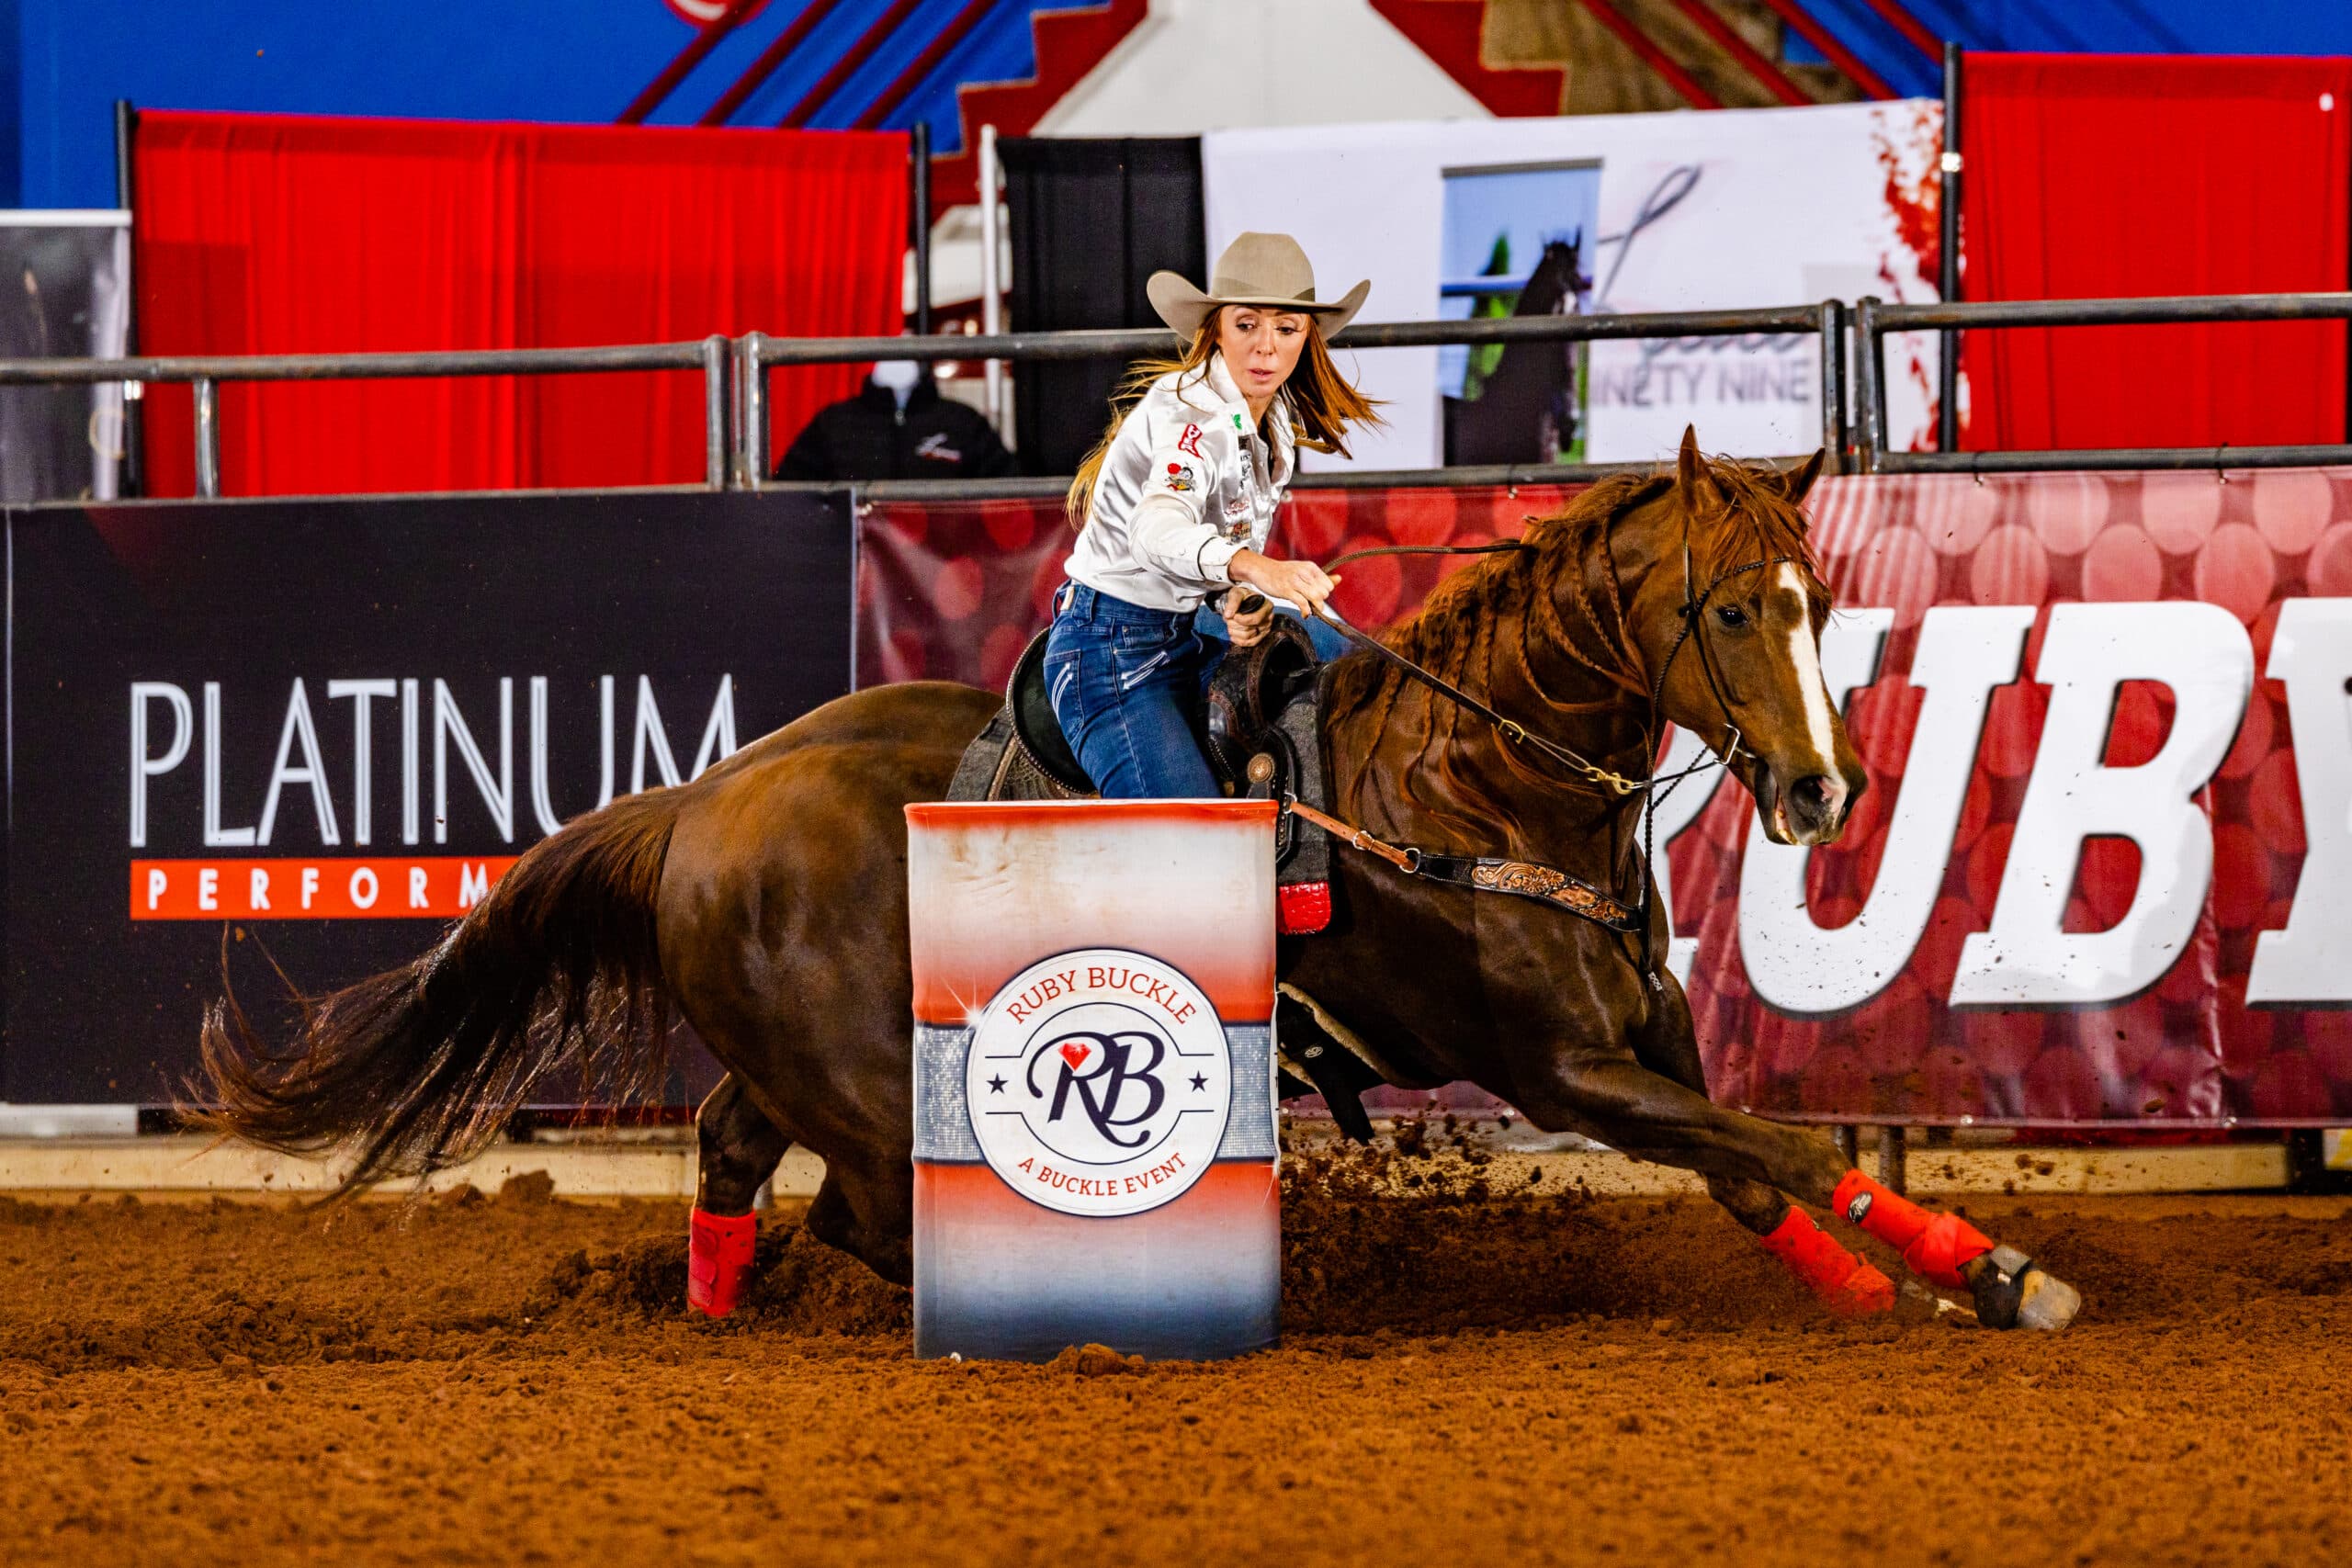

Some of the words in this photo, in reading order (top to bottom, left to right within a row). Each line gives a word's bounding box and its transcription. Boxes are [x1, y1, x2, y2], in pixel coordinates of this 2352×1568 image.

[1591, 363, 1707, 407] INETY
[1717, 358, 1812, 403] NINE
[130, 672, 737, 848] PLATINUM
[148, 862, 490, 911] PERFORM
[1006, 969, 1077, 1025] RUBY
[1087, 966, 1197, 1025] BUCKLE
[1025, 1031, 1166, 1149] RB
[1017, 1156, 1035, 1174] A
[1036, 1165, 1119, 1197] BUCKLE
[1125, 1151, 1187, 1194] EVENT
